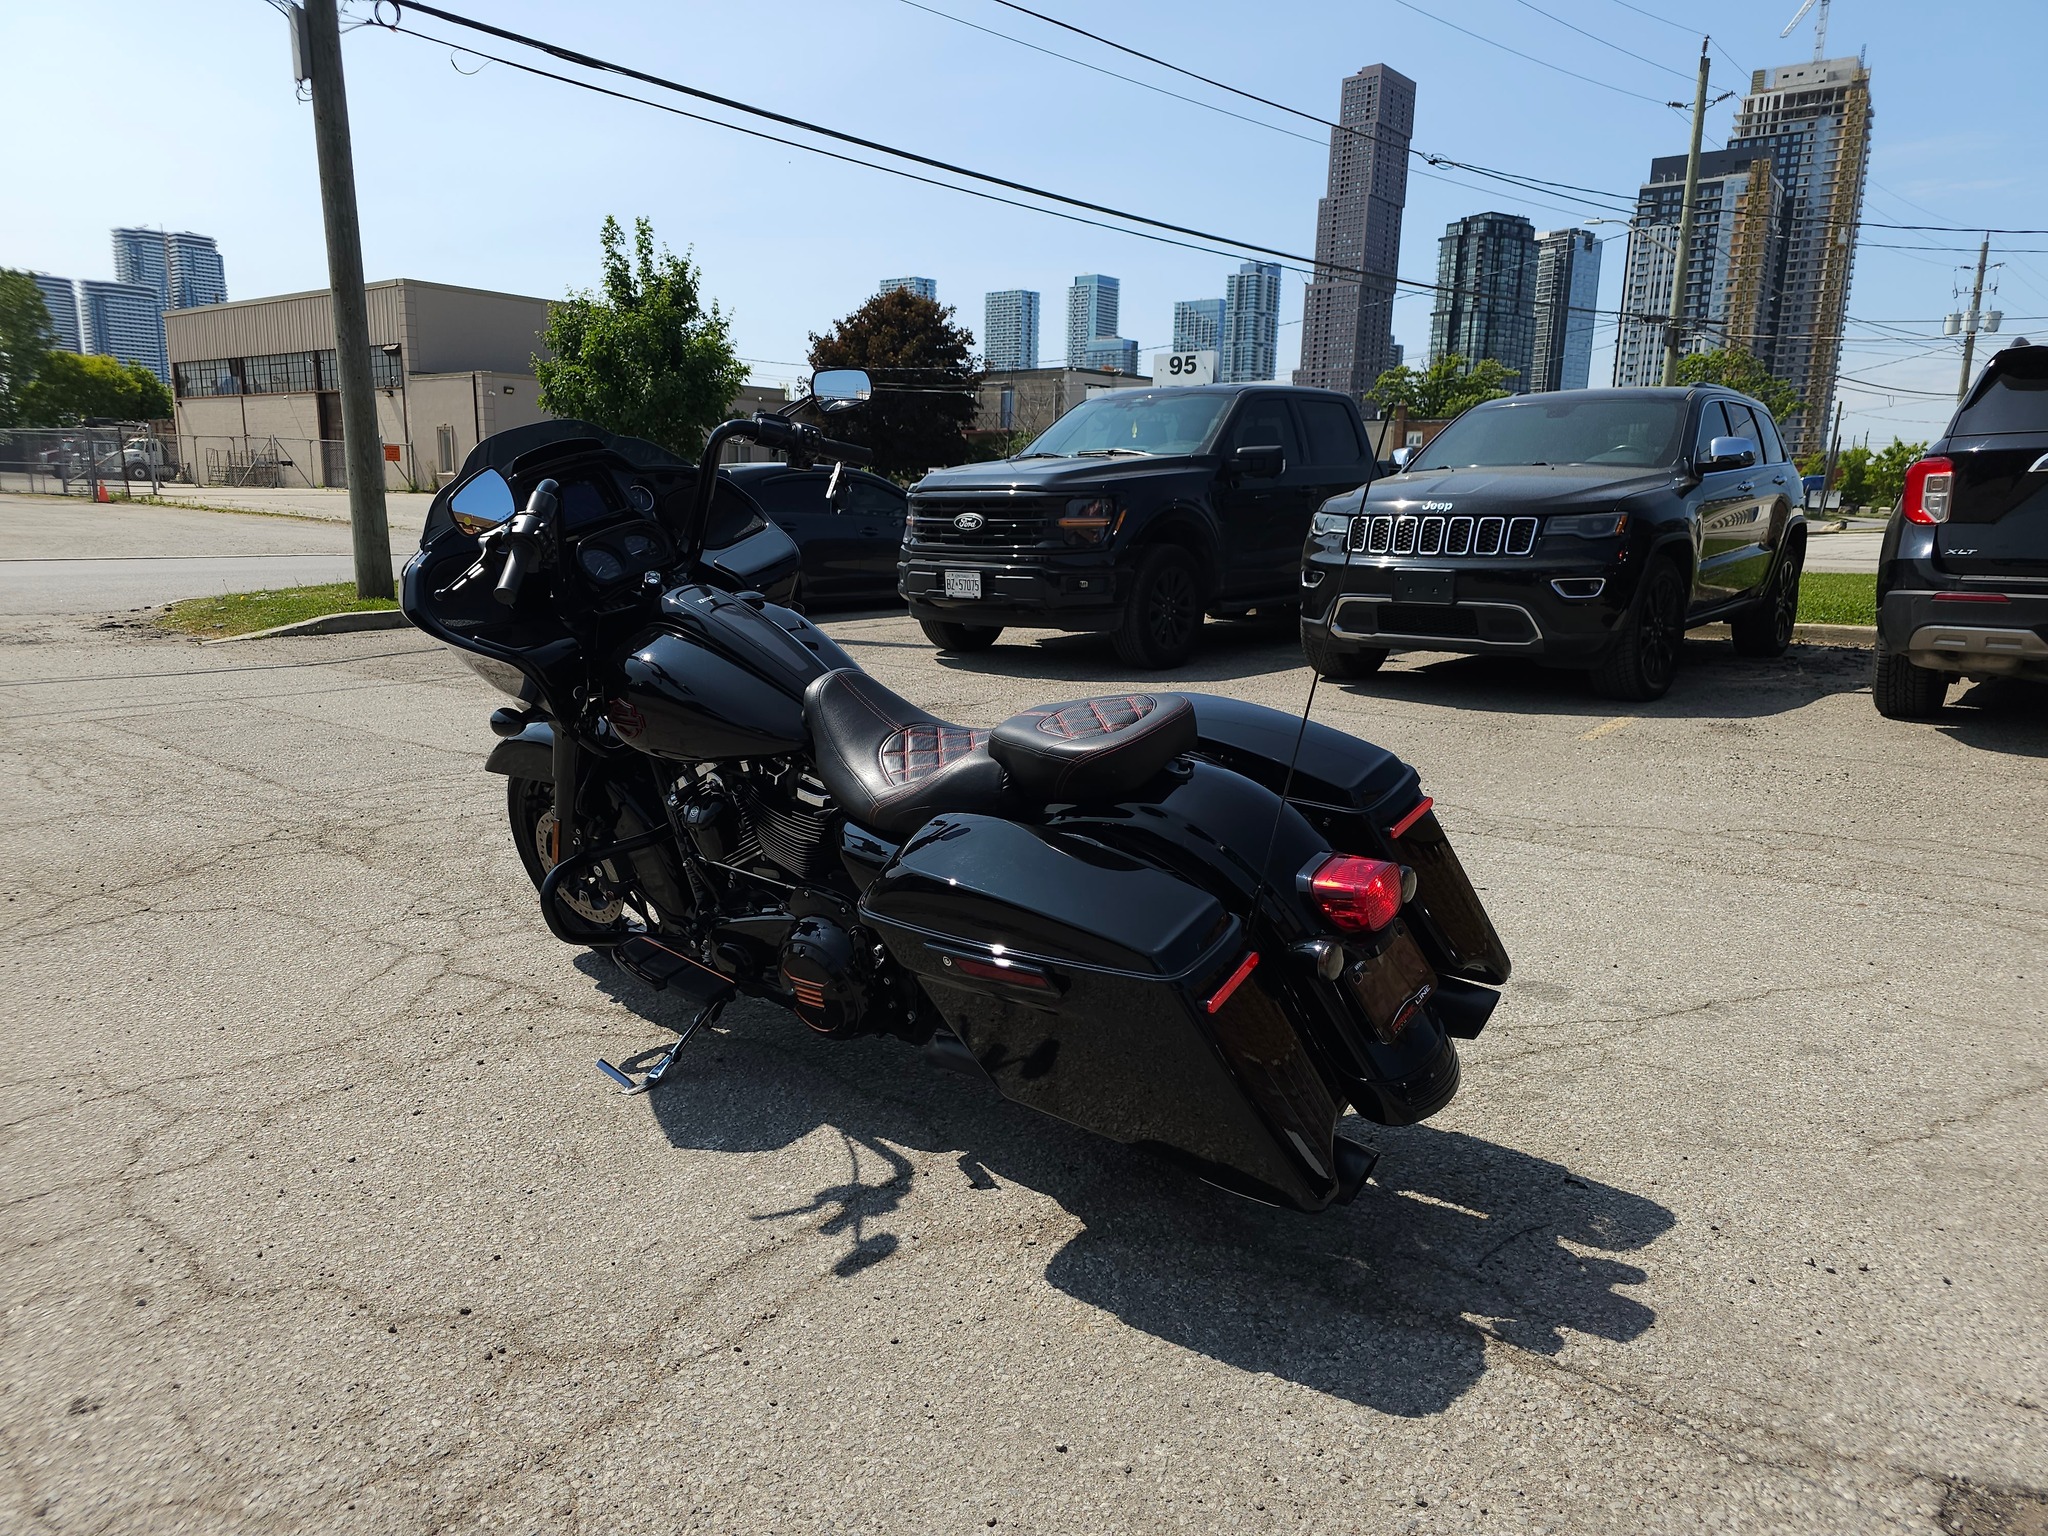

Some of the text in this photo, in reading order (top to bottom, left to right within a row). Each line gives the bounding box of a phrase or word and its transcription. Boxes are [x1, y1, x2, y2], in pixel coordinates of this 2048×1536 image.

[1169, 355, 1197, 375] 95
[1422, 501, 1453, 512] Jeep
[1415, 985, 1431, 1005] LINE
